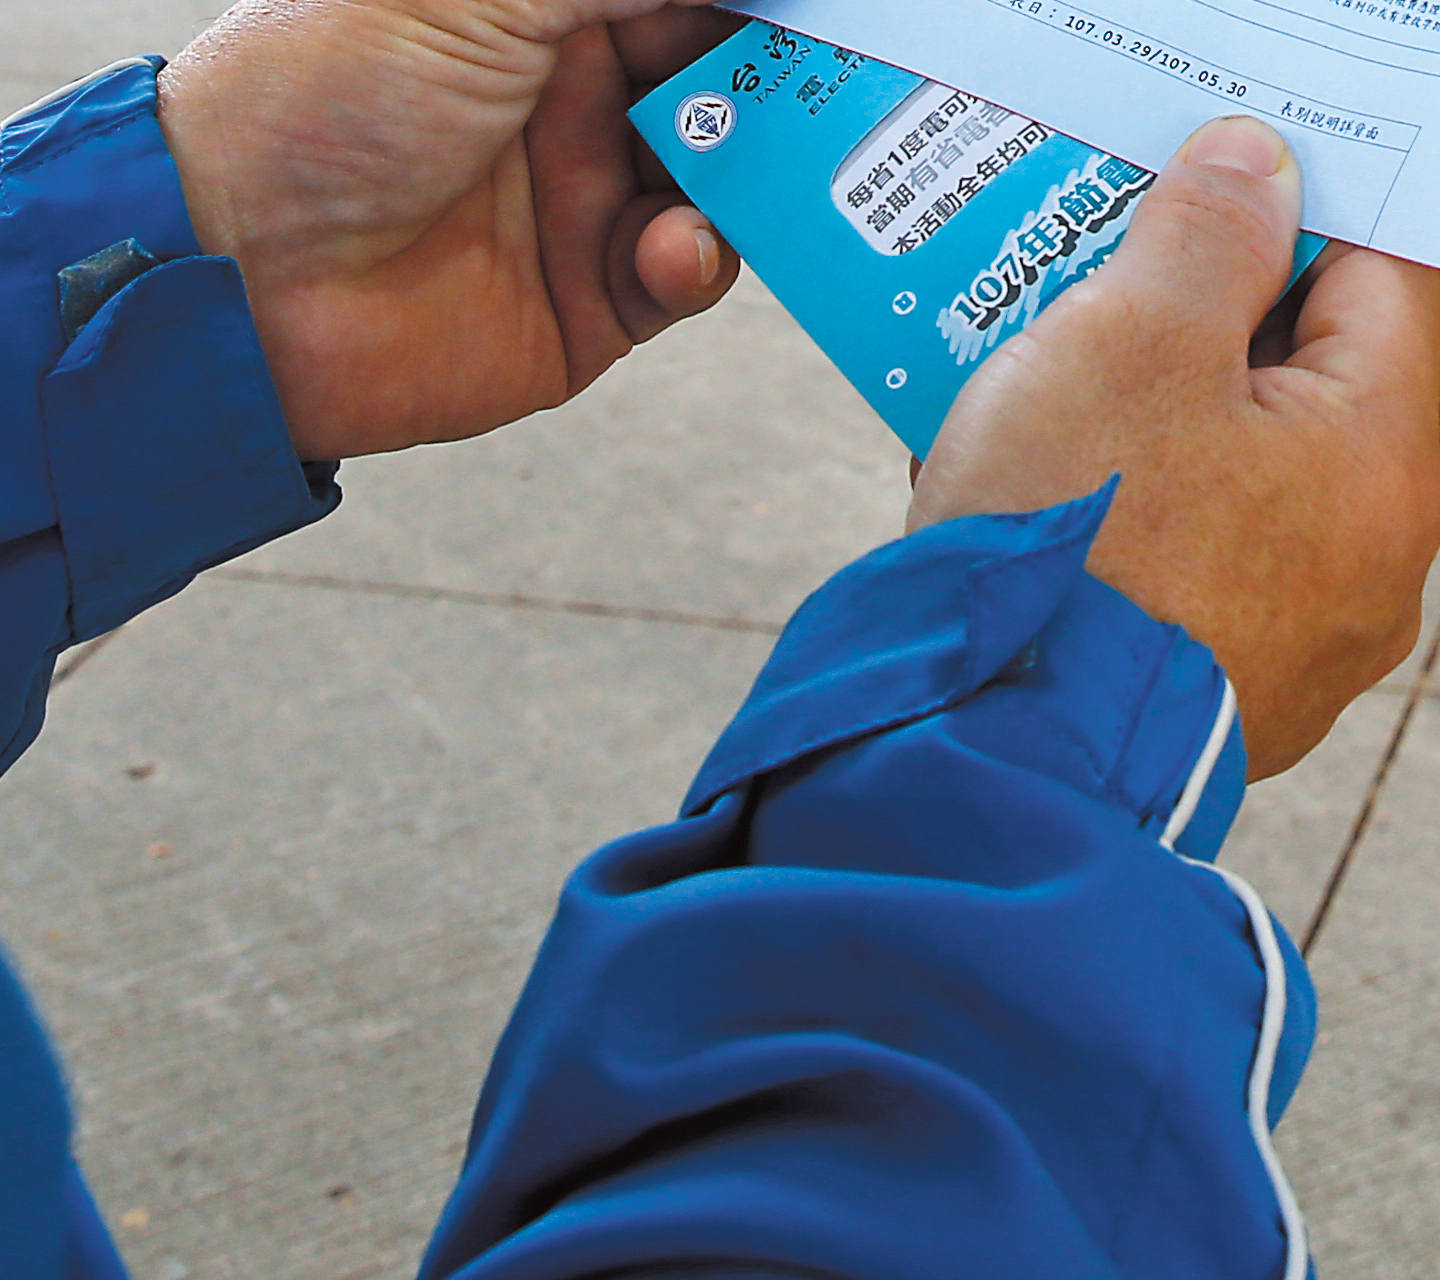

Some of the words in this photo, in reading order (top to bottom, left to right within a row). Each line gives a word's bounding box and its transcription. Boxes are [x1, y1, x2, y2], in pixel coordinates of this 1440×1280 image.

[753, 46, 813, 105] TAIWAN
[1064, 14, 1248, 99] 107.03.29/107.05.30
[847, 90, 979, 210] 每省1度電可
